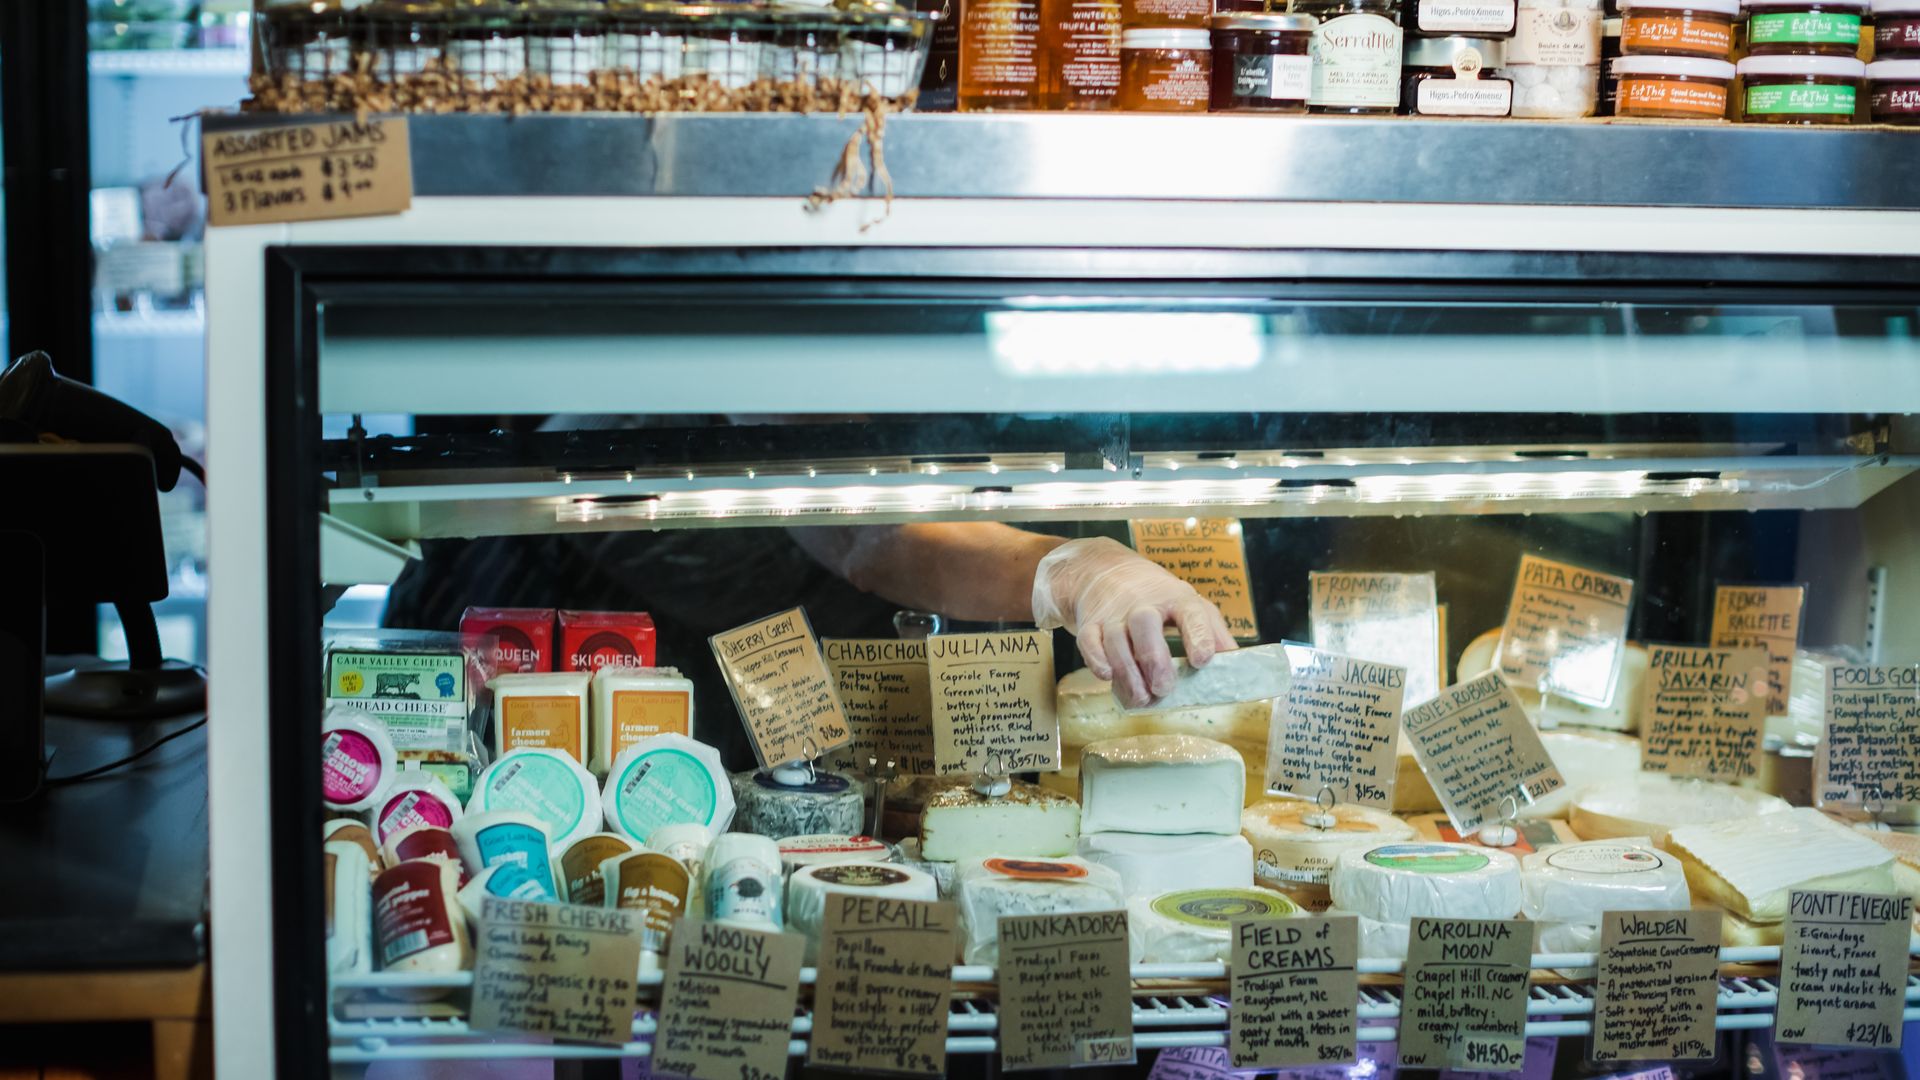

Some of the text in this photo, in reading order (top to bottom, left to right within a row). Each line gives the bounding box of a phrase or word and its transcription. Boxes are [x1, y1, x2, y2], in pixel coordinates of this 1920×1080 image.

[1641, 23, 1657, 34] Eat
[1658, 22, 1678, 35] This
[1792, 19, 1810, 31] Eat
[1811, 18, 1831, 31] This
[1631, 84, 1665, 96] Eat This
[1790, 91, 1808, 102] Eat
[1810, 89, 1829, 102] This
[1892, 90, 1907, 103] Eat
[213, 120, 386, 157] ASSORTED JAMS
[241, 188, 305, 211] Flavors
[1524, 562, 1623, 599] PATA CABRA
[1728, 613, 1792, 631] RACLETTE
[722, 617, 794, 658] SHERRY GRAY
[828, 642, 927, 661] CHABICHOU
[934, 635, 1040, 659] JULIANNA
[337, 656, 454, 667] CARR VALLEY CHEESE
[495, 649, 540, 662] QUEEN
[571, 655, 643, 667] SKI QUEEN
[1651, 650, 1731, 670] BRILLAT
[941, 669, 1021, 685] Capriole Farms
[1342, 662, 1402, 689] JACQUES
[1660, 668, 1748, 689] SAVARIN
[878, 683, 910, 694] France
[944, 682, 1016, 698] Greenville, IN
[1451, 675, 1507, 707] ROBIOLA
[395, 702, 447, 713] CHEESE
[947, 698, 1030, 714] buttery smooth
[1833, 694, 1916, 711] Prodigal Farm
[951, 709, 1032, 724] with pronounced
[511, 727, 551, 737] farmers
[620, 723, 659, 732] farmers
[1008, 723, 1032, 732] Rind
[511, 737, 546, 746] cheese
[954, 733, 1050, 747] coated with herbes
[1373, 734, 1389, 743] and
[966, 749, 978, 757] de
[1355, 742, 1373, 752] and
[835, 759, 858, 771] goat
[941, 761, 967, 774] goat
[1357, 766, 1376, 776] and
[1320, 771, 1350, 789] honey
[624, 885, 680, 907] fig honey
[1790, 892, 1838, 916] PONT
[482, 899, 632, 930] FRESH CHEVRE
[842, 898, 942, 928] PERAIL
[1002, 912, 1127, 942] HUNKADORA
[1418, 919, 1511, 941] CAROLINA
[1620, 914, 1687, 936] WALDEN
[702, 923, 765, 957] WOOLY
[1240, 923, 1301, 947] FIELD
[1316, 923, 1330, 939] of
[1015, 949, 1062, 969] Prodigal
[1248, 946, 1334, 969] CREAMS
[1442, 941, 1494, 961] MOON
[1609, 946, 1657, 961] Sequatchie
[1843, 948, 1877, 960] France
[685, 945, 771, 979] WOOLLY
[1656, 960, 1672, 970] TN
[1415, 968, 1529, 990] Chapel Hill Creamery
[1860, 964, 1881, 978] and
[1244, 977, 1318, 994] Prodigal Farm
[1608, 973, 1707, 990] A version
[1790, 981, 1897, 996] cream underlie the
[1058, 989, 1077, 1000] the
[1310, 991, 1328, 1001] NC
[1415, 985, 1513, 1005] Chapel NC
[1606, 988, 1696, 1004] their Dancing Fern
[1606, 1002, 1692, 1020] Soft supple with
[1843, 999, 1877, 1010] aroma
[1281, 1008, 1350, 1020] with a sweet
[1417, 1004, 1489, 1024] mild, buttery
[1240, 1022, 1350, 1043] goaty Melts in
[1418, 1020, 1519, 1037] creamy camembert
[1604, 1026, 1680, 1041] Notes of butter
[1847, 1023, 1893, 1046] $23/lb
[1247, 1033, 1310, 1050] your mouth
[1433, 1033, 1463, 1048] style
[1619, 1038, 1668, 1049] mushrooms
[1005, 1048, 1034, 1068] goat
[1233, 1051, 1259, 1067] goat
